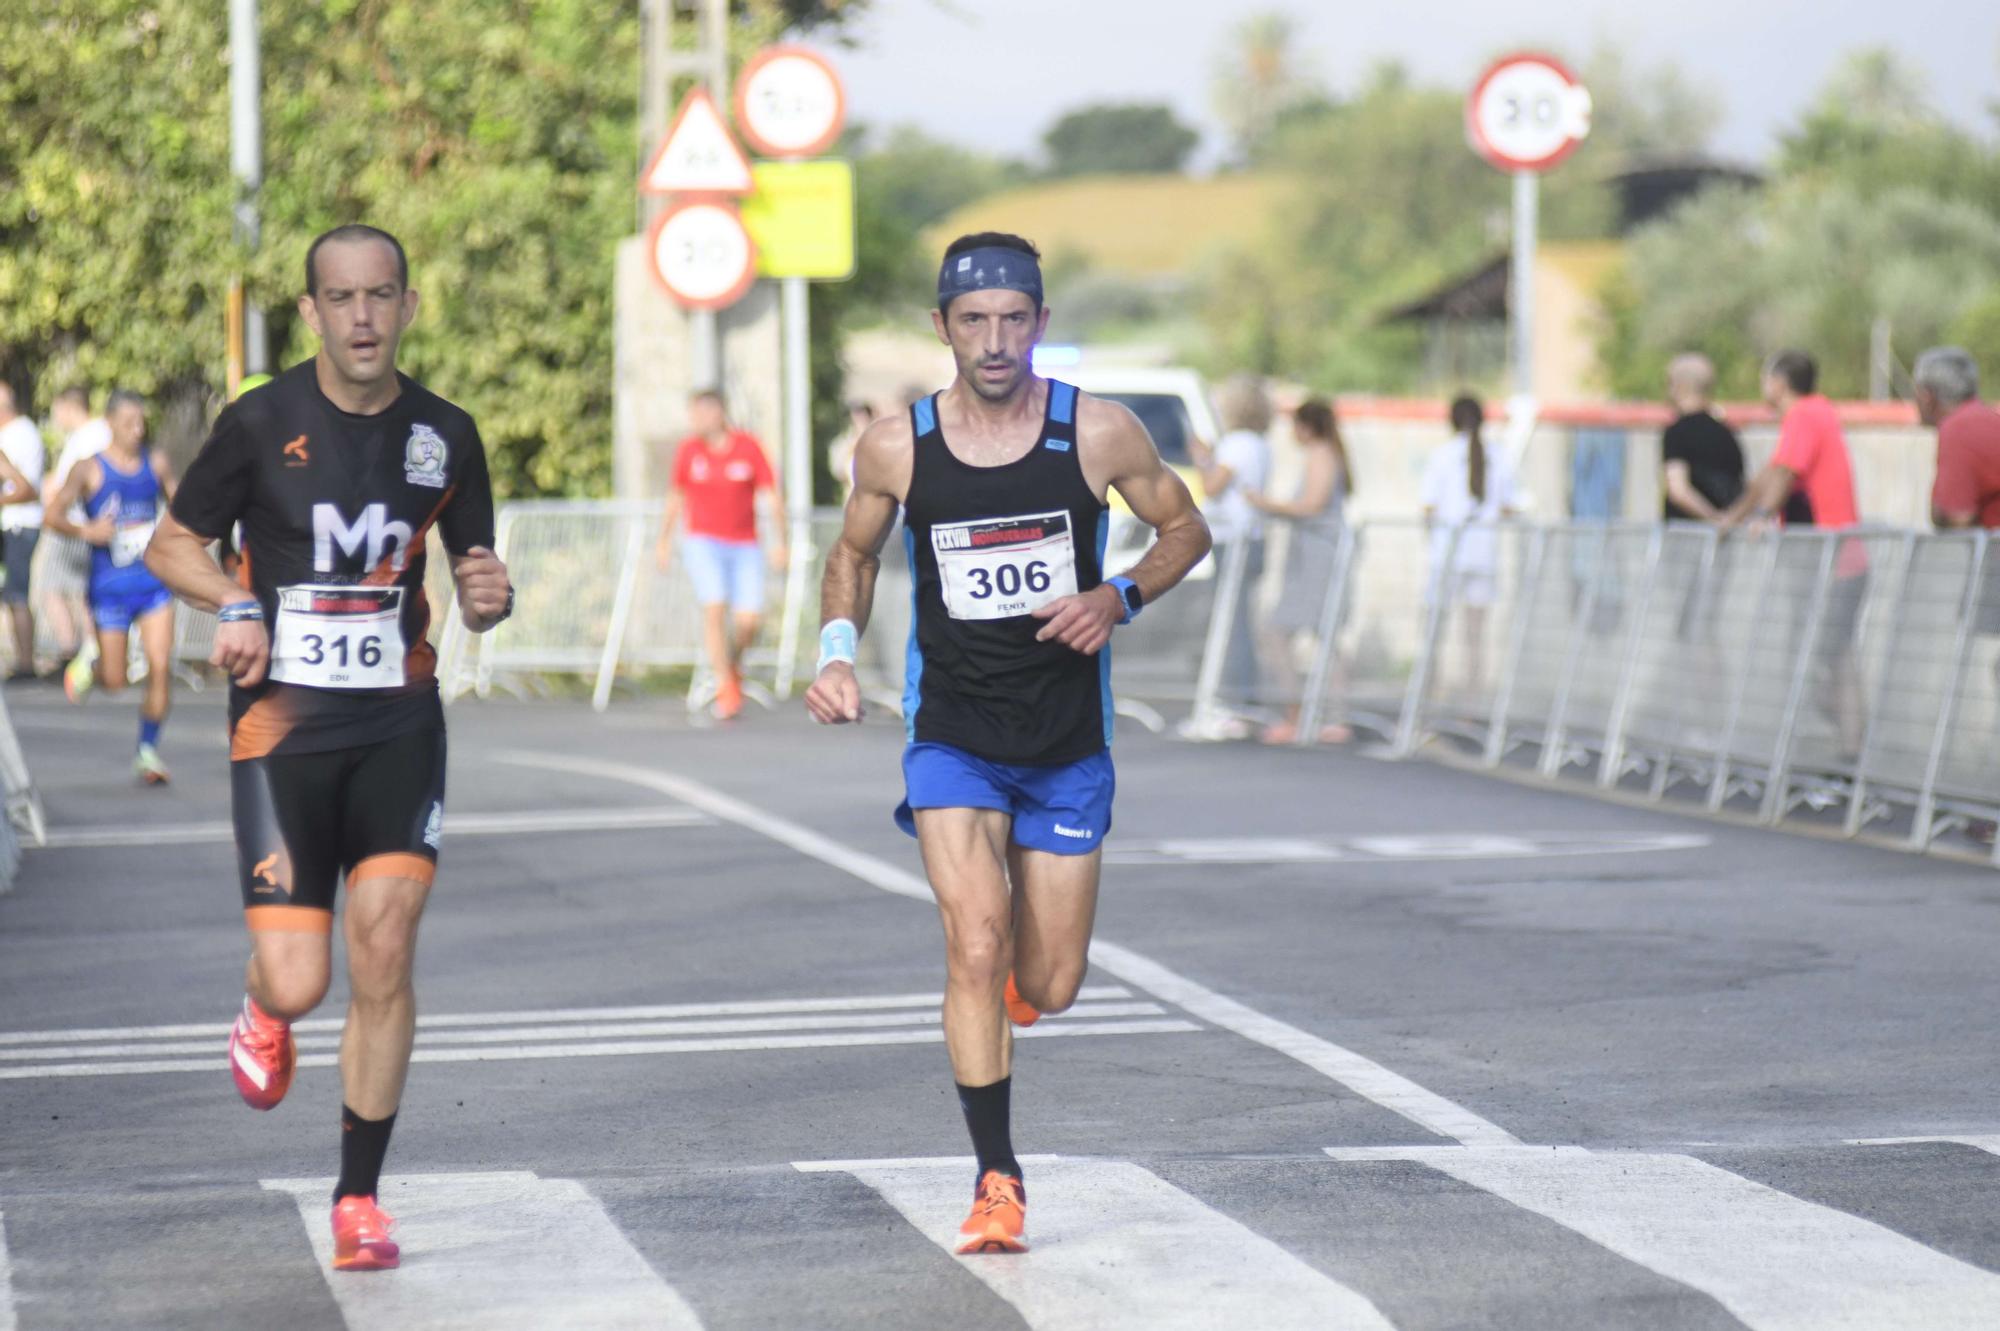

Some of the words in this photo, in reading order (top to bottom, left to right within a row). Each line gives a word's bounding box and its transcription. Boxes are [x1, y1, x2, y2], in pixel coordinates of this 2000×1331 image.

[313, 503, 412, 573] Mh
[967, 560, 1050, 600] 306
[997, 602, 1027, 611] FENIX
[301, 634, 381, 668] 316
[329, 674, 350, 682] EDU
